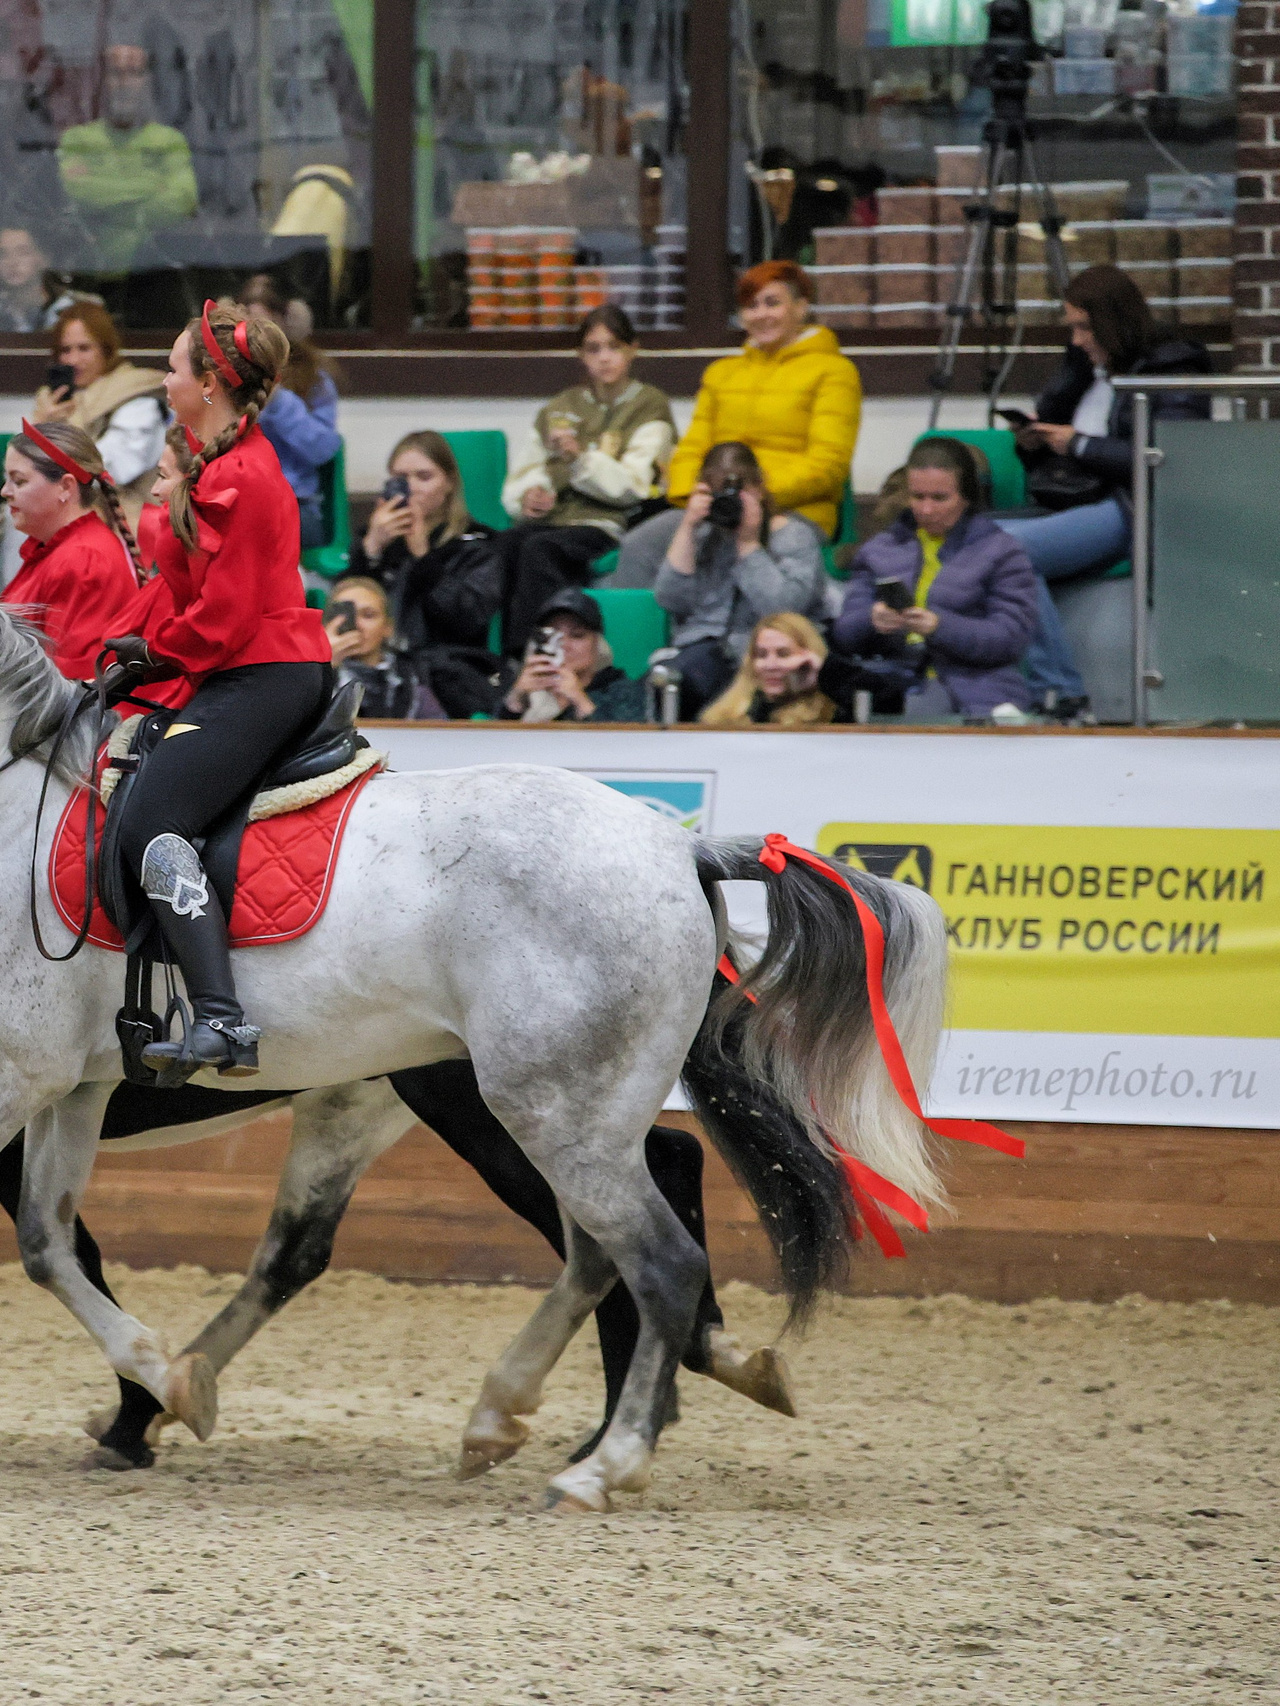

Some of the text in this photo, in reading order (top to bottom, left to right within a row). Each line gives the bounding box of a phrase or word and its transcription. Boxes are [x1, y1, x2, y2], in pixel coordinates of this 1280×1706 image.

[946, 861, 1265, 902] ГАННОВЕРСКИЙ
[946, 916, 1221, 955] КЛУБ РОССИИ
